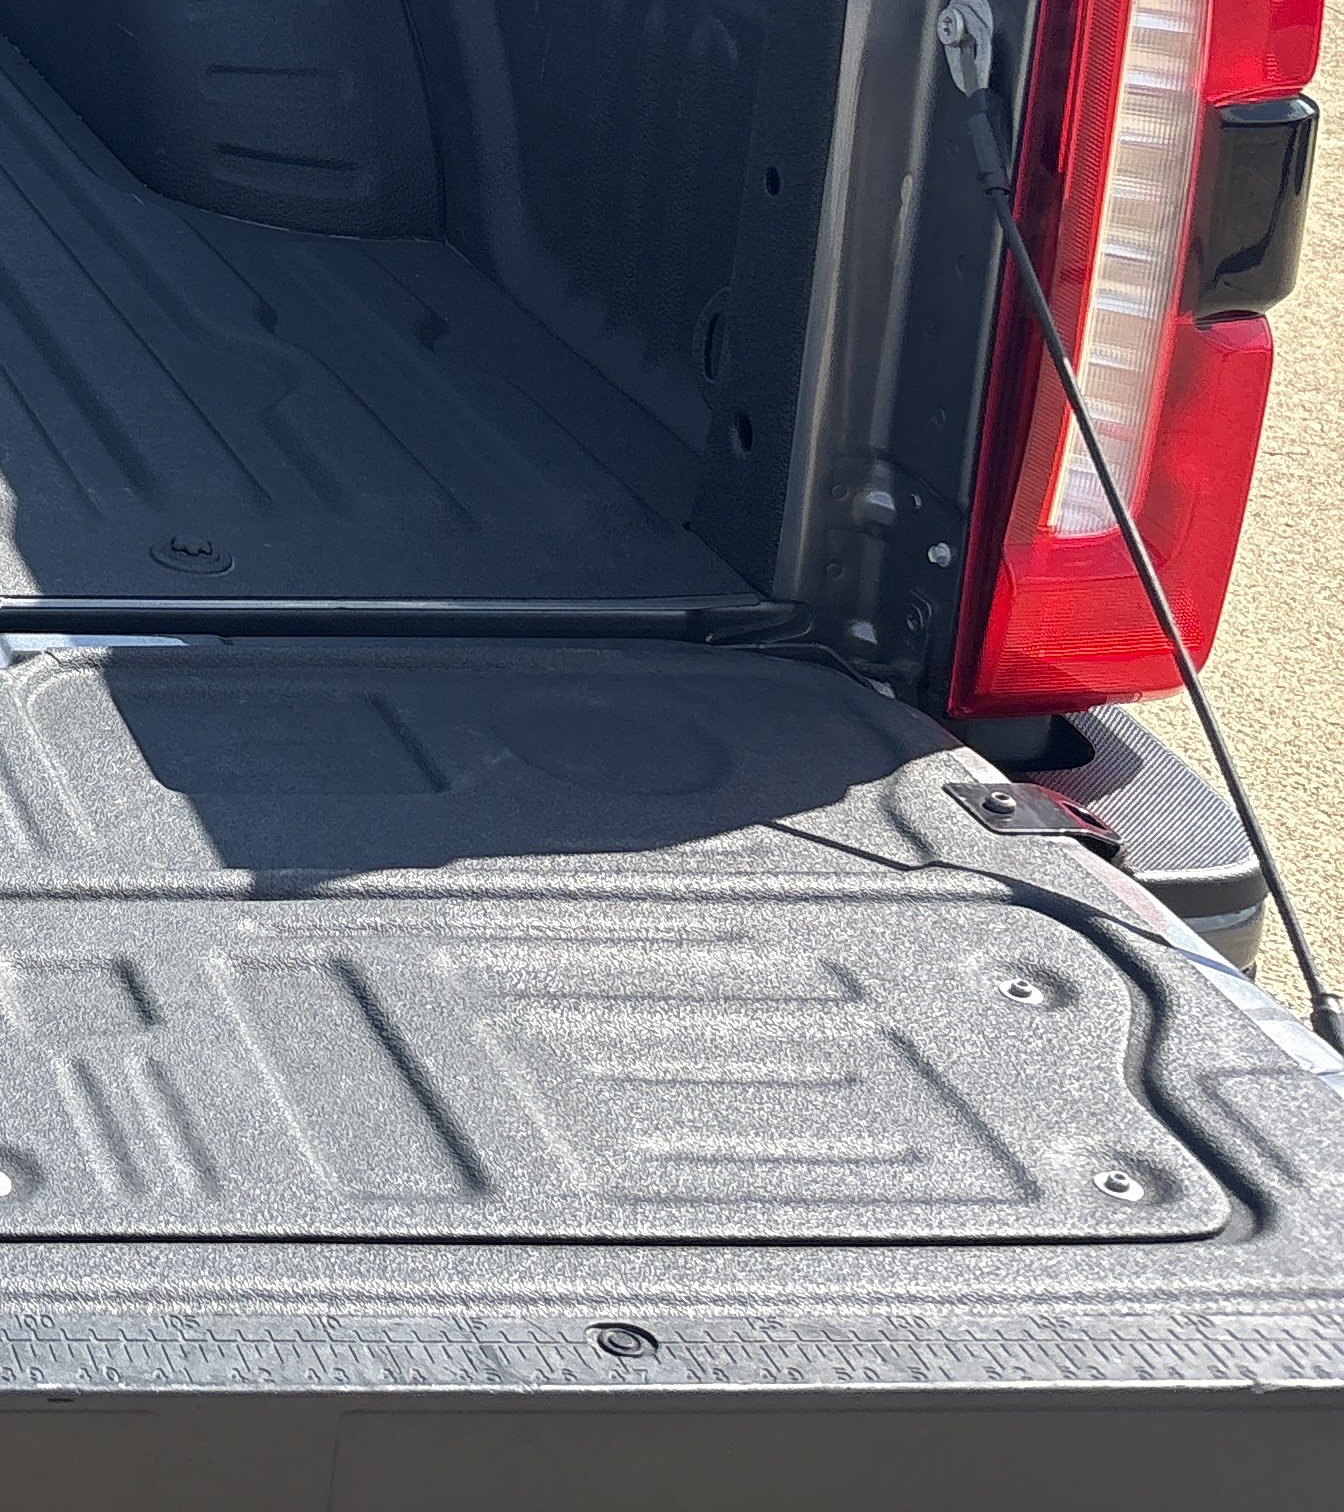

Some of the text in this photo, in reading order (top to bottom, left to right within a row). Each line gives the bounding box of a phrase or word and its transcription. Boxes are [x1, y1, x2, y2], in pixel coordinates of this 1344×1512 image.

[17, 1314, 55, 1330] 100
[161, 1314, 201, 1330] 105
[0, 1367, 44, 1382] 39
